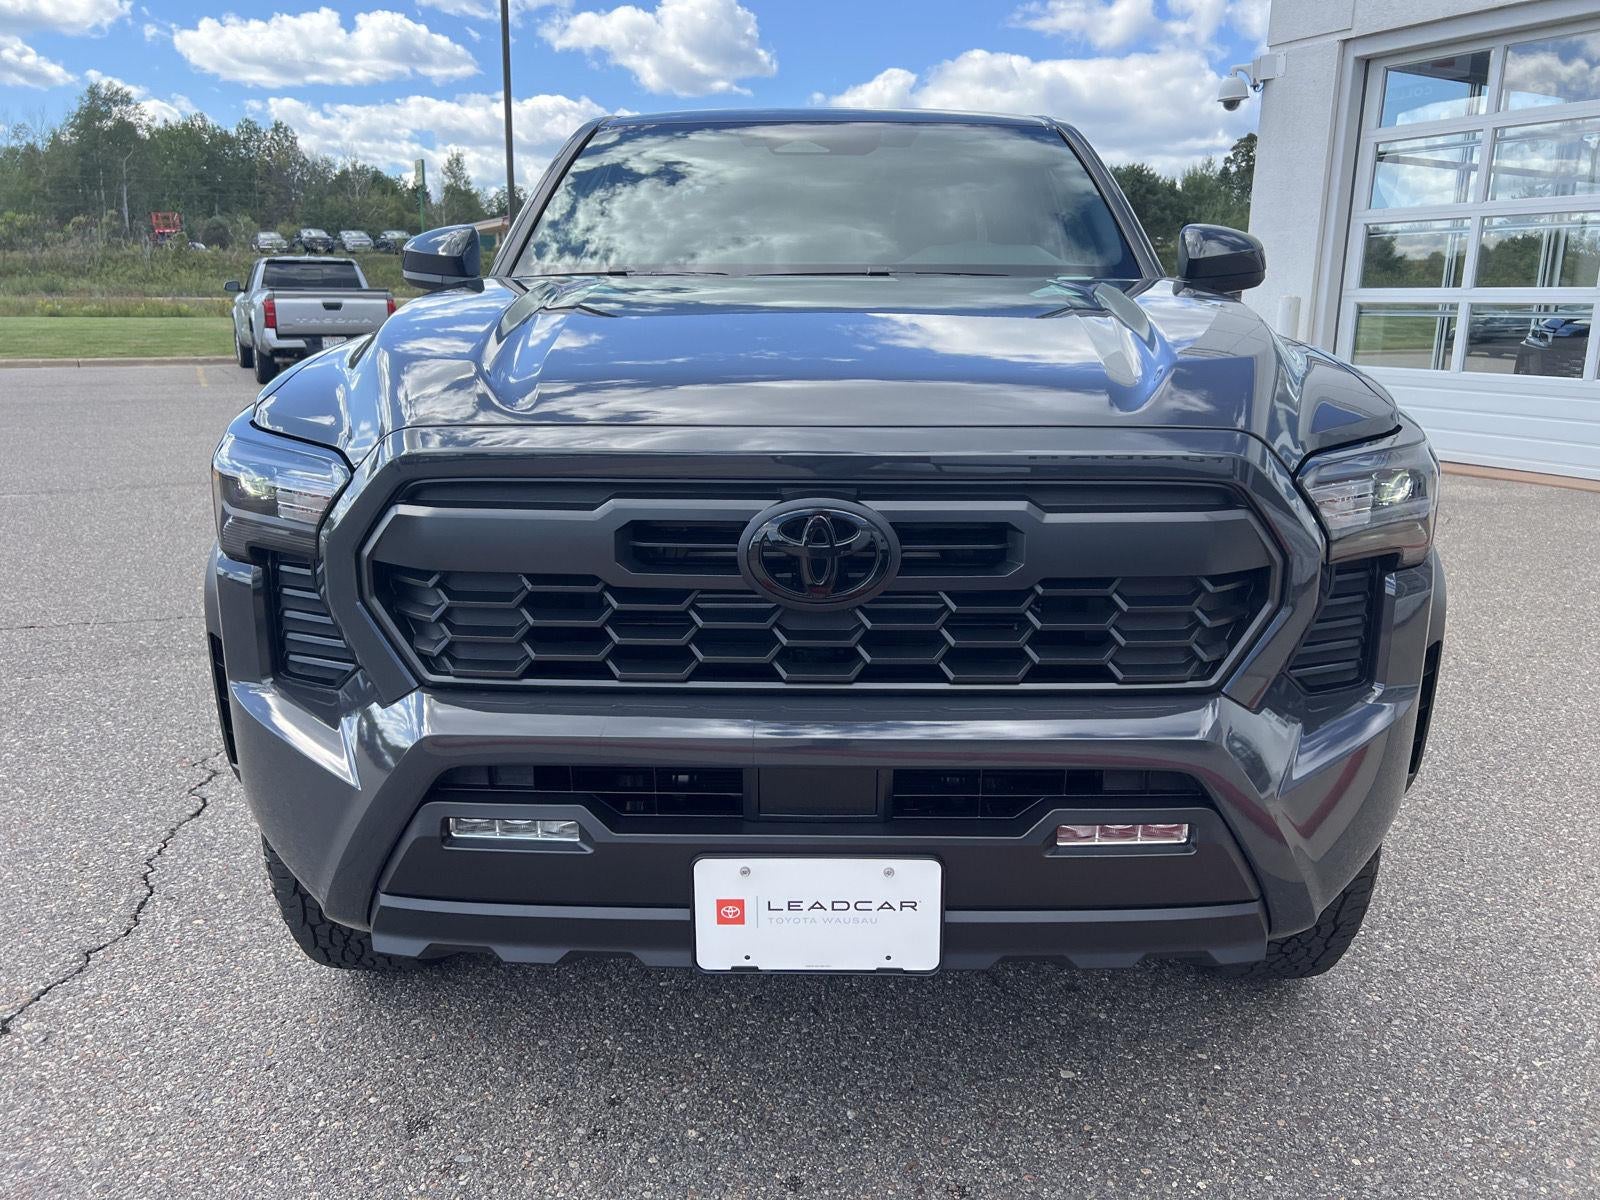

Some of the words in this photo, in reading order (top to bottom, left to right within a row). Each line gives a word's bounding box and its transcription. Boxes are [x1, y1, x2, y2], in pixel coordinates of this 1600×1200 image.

[767, 900, 918, 912] LEADCAR
[768, 917, 817, 925] TOYOTA
[822, 917, 878, 925] WAUSAU
